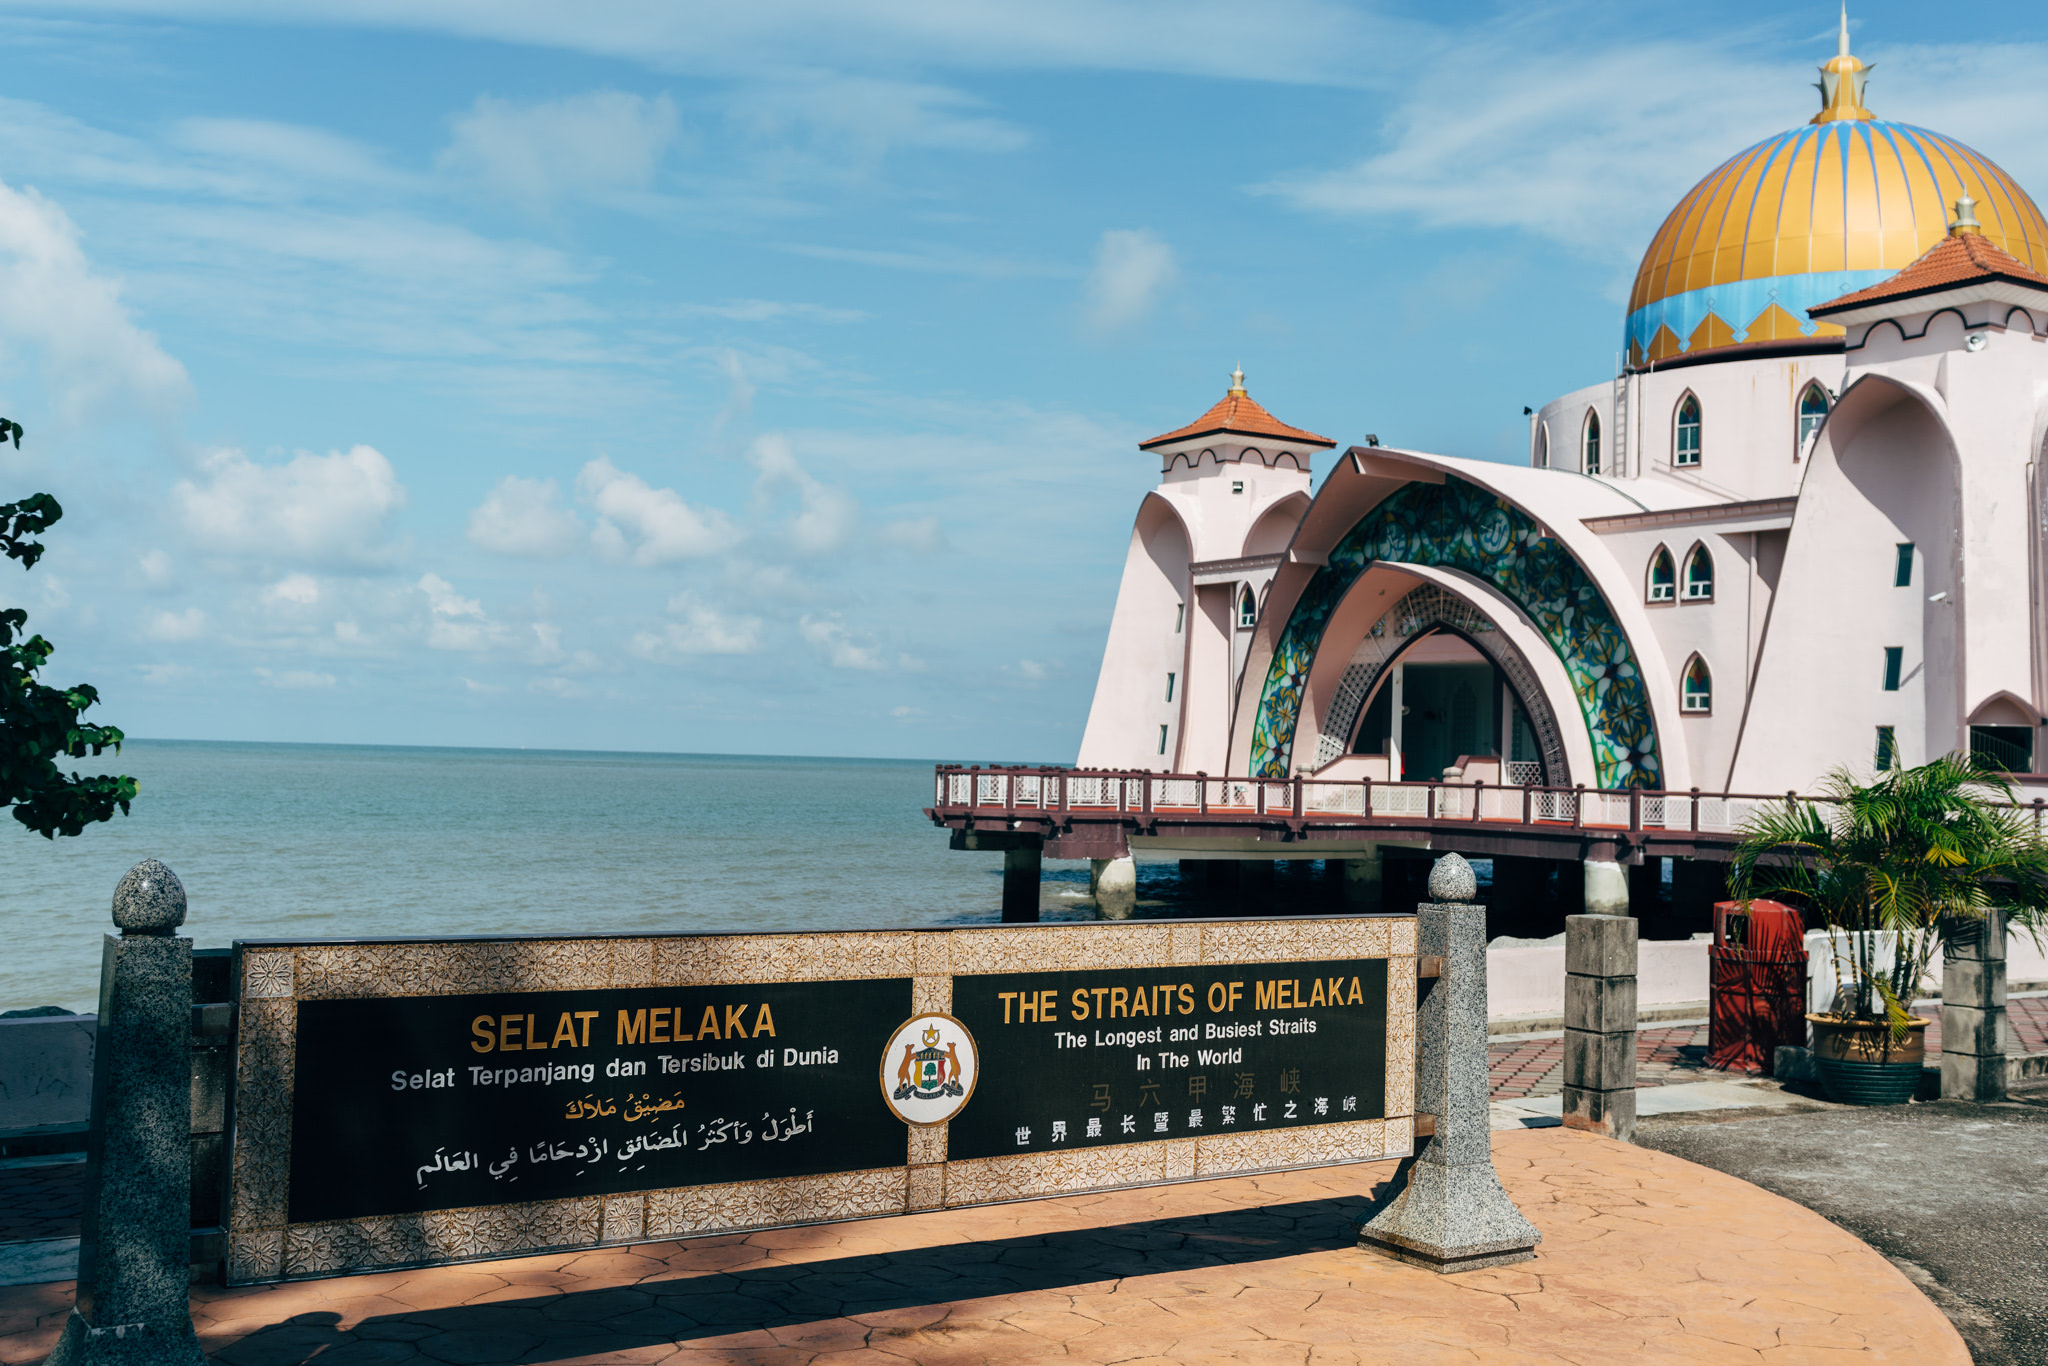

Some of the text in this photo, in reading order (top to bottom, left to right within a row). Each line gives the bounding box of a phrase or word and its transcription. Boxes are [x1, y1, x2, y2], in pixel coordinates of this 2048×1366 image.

[998, 976, 1364, 1024] THE STRAITS OF MELAKA
[470, 1003, 777, 1053] SELAT MELAKA
[1054, 1017, 1317, 1049] The Longest and Busiest Straits
[391, 1045, 839, 1091] Selat Terpanjang dan Tersibuk di Dunia
[1136, 1048, 1243, 1071] In The World
[1090, 1067, 1300, 1112] 马六甲海峡
[1015, 1095, 1358, 1147] 世界最长暨最繁忙之海峡
